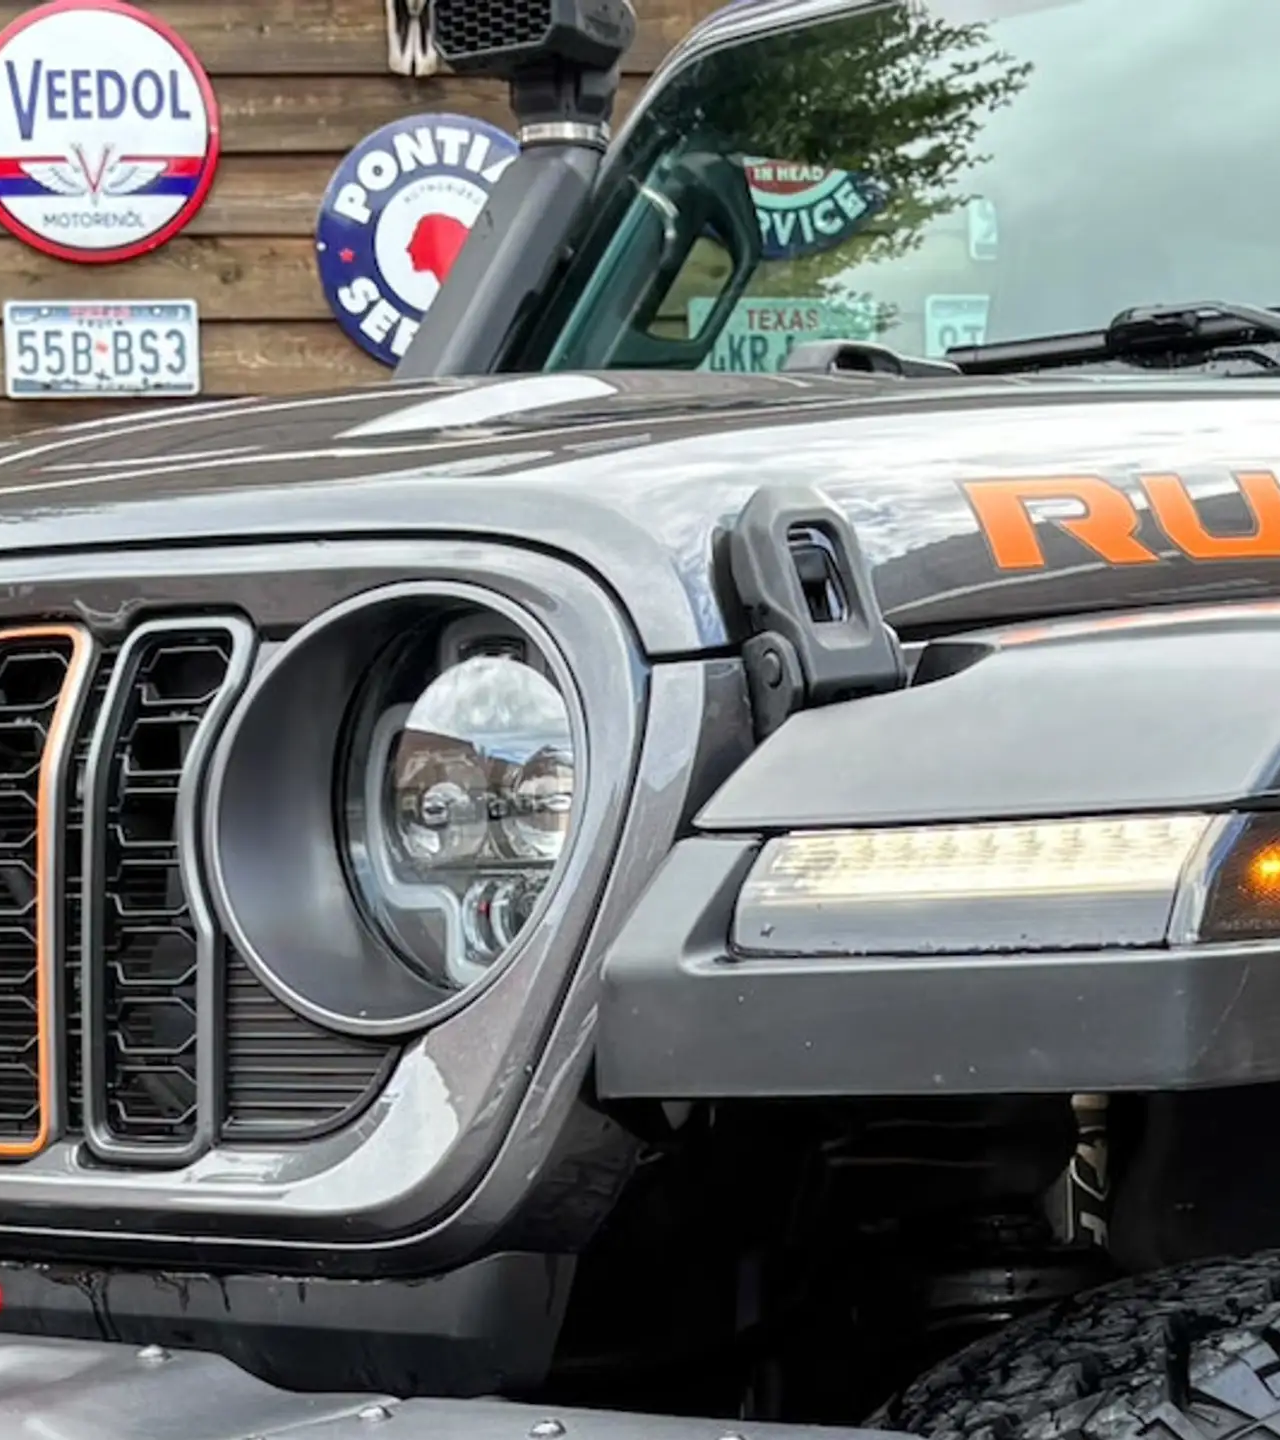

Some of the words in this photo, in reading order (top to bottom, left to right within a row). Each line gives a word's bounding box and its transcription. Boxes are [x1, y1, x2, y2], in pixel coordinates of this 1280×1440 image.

[5, 59, 191, 141] VEEDOL
[747, 308, 819, 332] TEXAS
[17, 330, 93, 376] 55B
[113, 328, 187, 376] BS3
